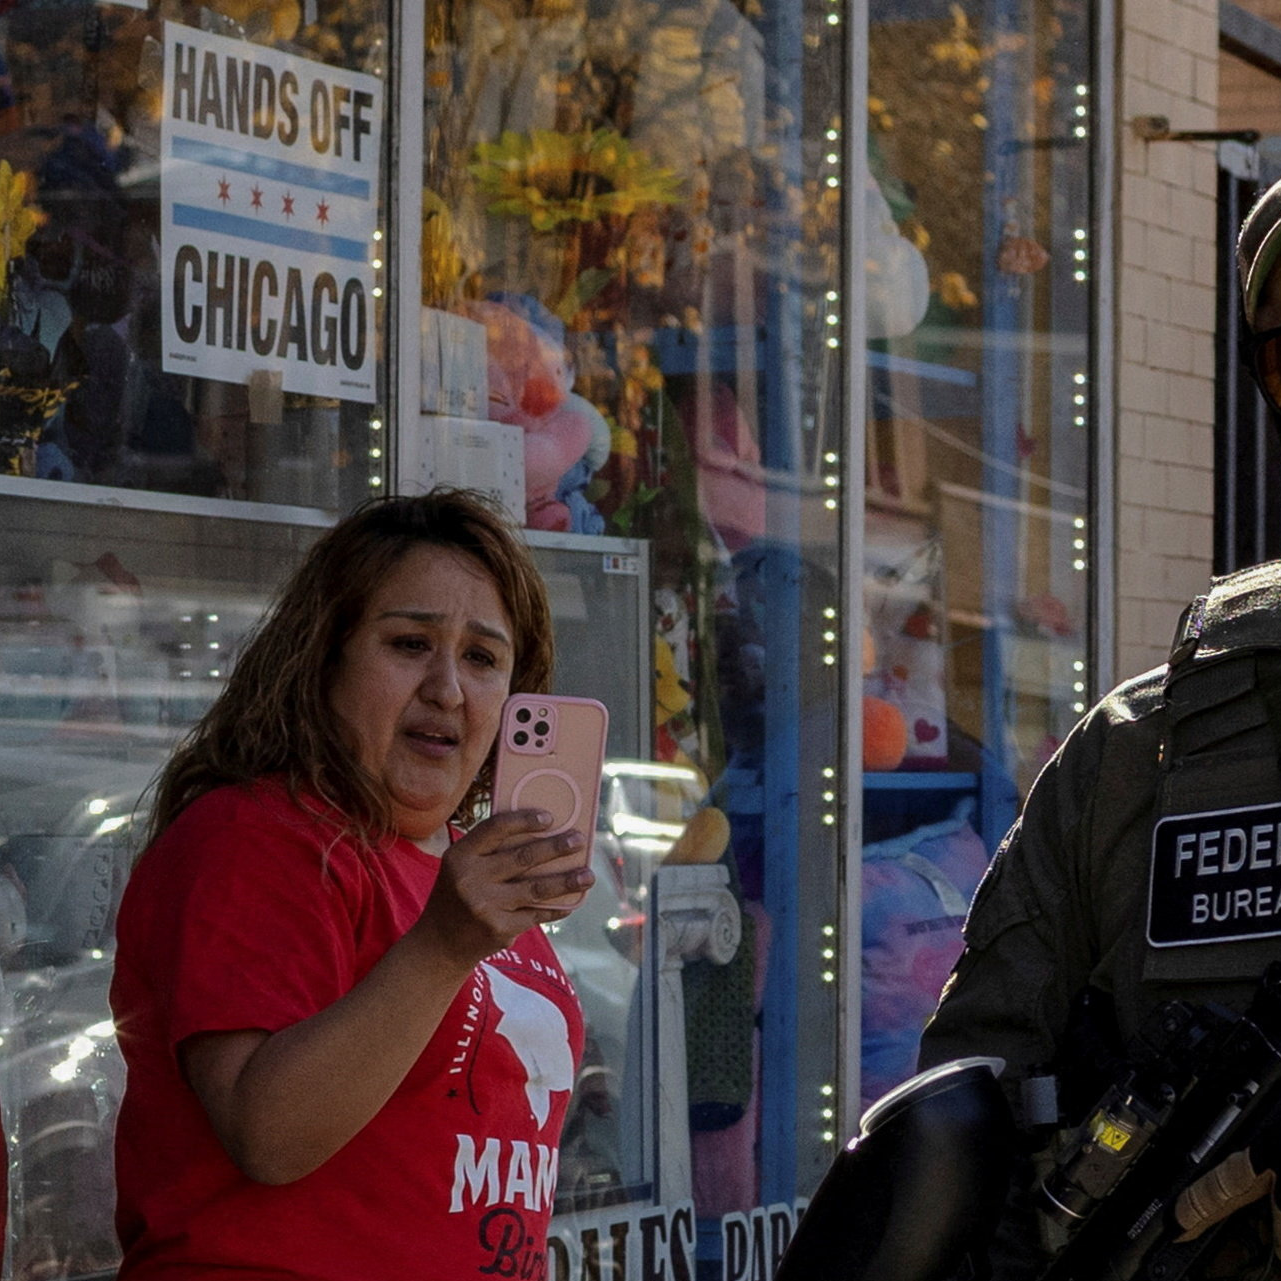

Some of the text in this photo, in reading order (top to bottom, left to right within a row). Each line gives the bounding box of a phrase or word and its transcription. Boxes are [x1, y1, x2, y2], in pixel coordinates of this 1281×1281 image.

[172, 42, 374, 163] HANDS OFF
[173, 243, 368, 372] CHICAGO
[449, 966, 485, 1075] ILLINOIS
